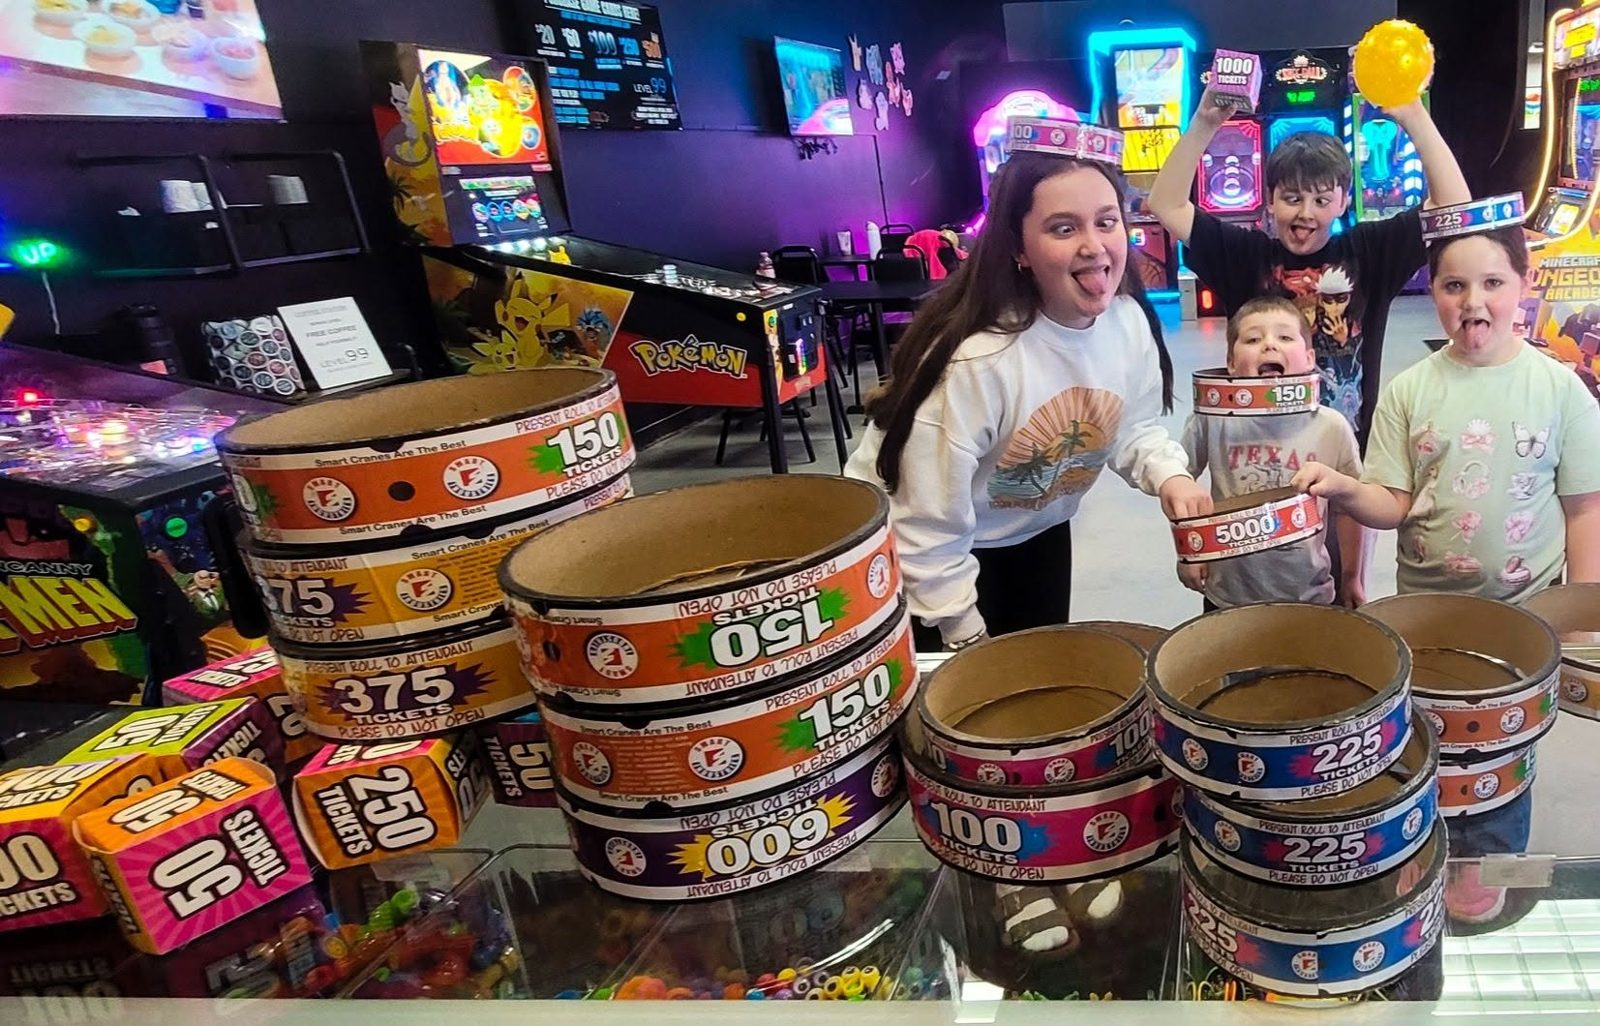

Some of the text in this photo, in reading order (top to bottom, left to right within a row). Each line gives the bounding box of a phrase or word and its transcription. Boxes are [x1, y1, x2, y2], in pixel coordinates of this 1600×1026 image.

[1216, 57, 1253, 75] 1000
[1217, 74, 1247, 85] TICKETS
[1010, 124, 1033, 139] 00
[1434, 212, 1463, 228] 225
[18, 240, 58, 265] UP
[328, 325, 358, 335] COFFEE
[345, 347, 369, 362] 99
[1272, 385, 1306, 401] 150
[515, 412, 561, 433] PRESENT
[314, 439, 467, 468] Smart Cranes Are The Best
[546, 411, 621, 467] 150
[562, 446, 622, 479] TICKETS
[546, 475, 587, 499] PLEASE
[340, 505, 487, 535] Smart Cranes Are The Best
[1215, 515, 1276, 543] 5000
[411, 519, 550, 560] Smart Cranes Are The Best
[0, 560, 93, 576] NCANNY
[679, 560, 838, 617] PLEASE DO NOT OPEN
[433, 609, 465, 622] Smart
[713, 585, 821, 626] TICKETS
[330, 628, 365, 641] OPEN
[709, 600, 835, 667] 150
[351, 660, 382, 673] ROLL
[385, 657, 400, 669] TO
[406, 641, 474, 666] ATTENDANT
[686, 629, 858, 696] PRESENT ROLL TO ATTENDANT
[333, 667, 456, 714] 375
[766, 683, 818, 710] PRESENT
[823, 670, 848, 686] ROLL
[800, 663, 891, 739] 150
[152, 704, 221, 747] TICKETS
[338, 708, 485, 738] PLEASE DO NOT OPEN
[352, 703, 454, 726] TICKETS
[607, 728, 640, 737] Cranes
[643, 727, 661, 736] Are
[663, 725, 685, 734] The
[687, 720, 713, 731] Best
[814, 700, 891, 752] TICKETS
[93, 713, 183, 753] 50
[1109, 710, 1151, 758] 100
[1290, 731, 1329, 745] PRESENT
[1332, 727, 1352, 738] ROLL
[1311, 724, 1384, 773] 225
[483, 735, 522, 798] TICKETS
[511, 743, 555, 791] 50
[793, 746, 842, 777] PLEASE
[844, 736, 862, 750] DO
[1320, 753, 1380, 781] TICKETS
[0, 784, 78, 809] CKETS
[181, 769, 249, 802] TICKETS
[659, 793, 679, 802] Are
[681, 791, 701, 800] The
[703, 786, 729, 798] Best
[681, 773, 836, 830] PLEASE DO NOT OPEN
[1301, 783, 1339, 797] PLEASE
[110, 788, 202, 833] 50
[348, 767, 437, 850] 250
[712, 799, 818, 838] TICKETS
[970, 796, 1047, 812] TO ATTENDANT
[318, 785, 373, 856] TICKETS
[930, 801, 1022, 853] 100
[1259, 820, 1299, 834] PRESENT
[1301, 823, 1326, 834] ROLL
[1341, 813, 1386, 832] ATTENDANT
[222, 809, 288, 887] TICKETS
[706, 809, 830, 876] 600
[940, 835, 1019, 865] TICKETS
[1283, 832, 1367, 863] 225
[0, 834, 59, 891] 00
[152, 838, 244, 919] 50
[687, 832, 858, 898] PRESENT ROLL TO ATTENDANT
[982, 864, 1004, 877] NOT
[1009, 867, 1046, 880] OPEN
[1269, 864, 1379, 884] PLEASE DO NOT OPEN
[1288, 860, 1360, 873] TICKETS
[0, 882, 77, 917] CKETS
[1184, 892, 1238, 952] 225
